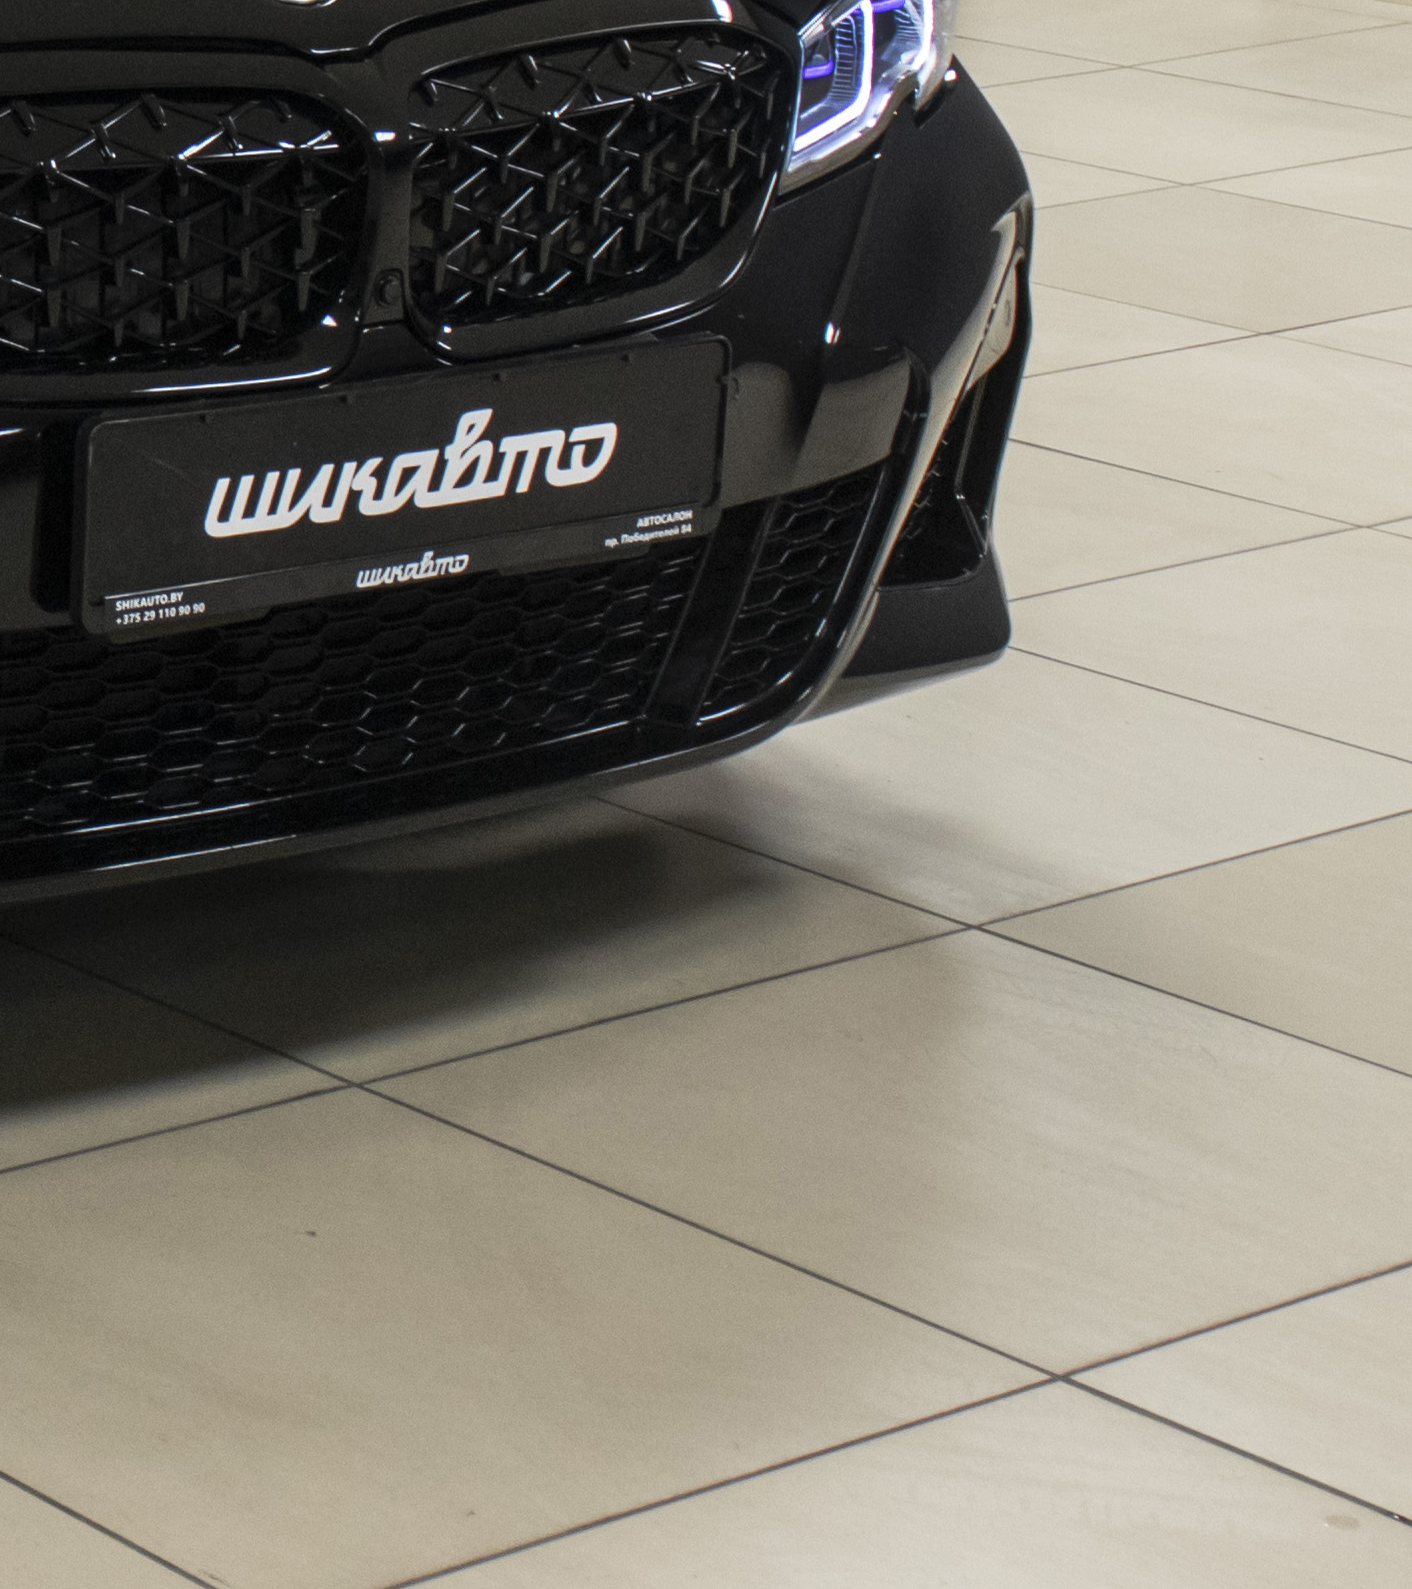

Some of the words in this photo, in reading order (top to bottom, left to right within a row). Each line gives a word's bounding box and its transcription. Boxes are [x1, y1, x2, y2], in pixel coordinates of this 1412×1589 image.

[204, 407, 618, 538] шикавто
[637, 509, 693, 528] АВТОСАЛОН
[115, 592, 183, 611] SHIKAUTO.BY
[116, 611, 142, 625] +375
[143, 610, 156, 622] 29
[158, 607, 177, 619] 110
[178, 604, 191, 617] 90
[192, 602, 206, 615] 90
